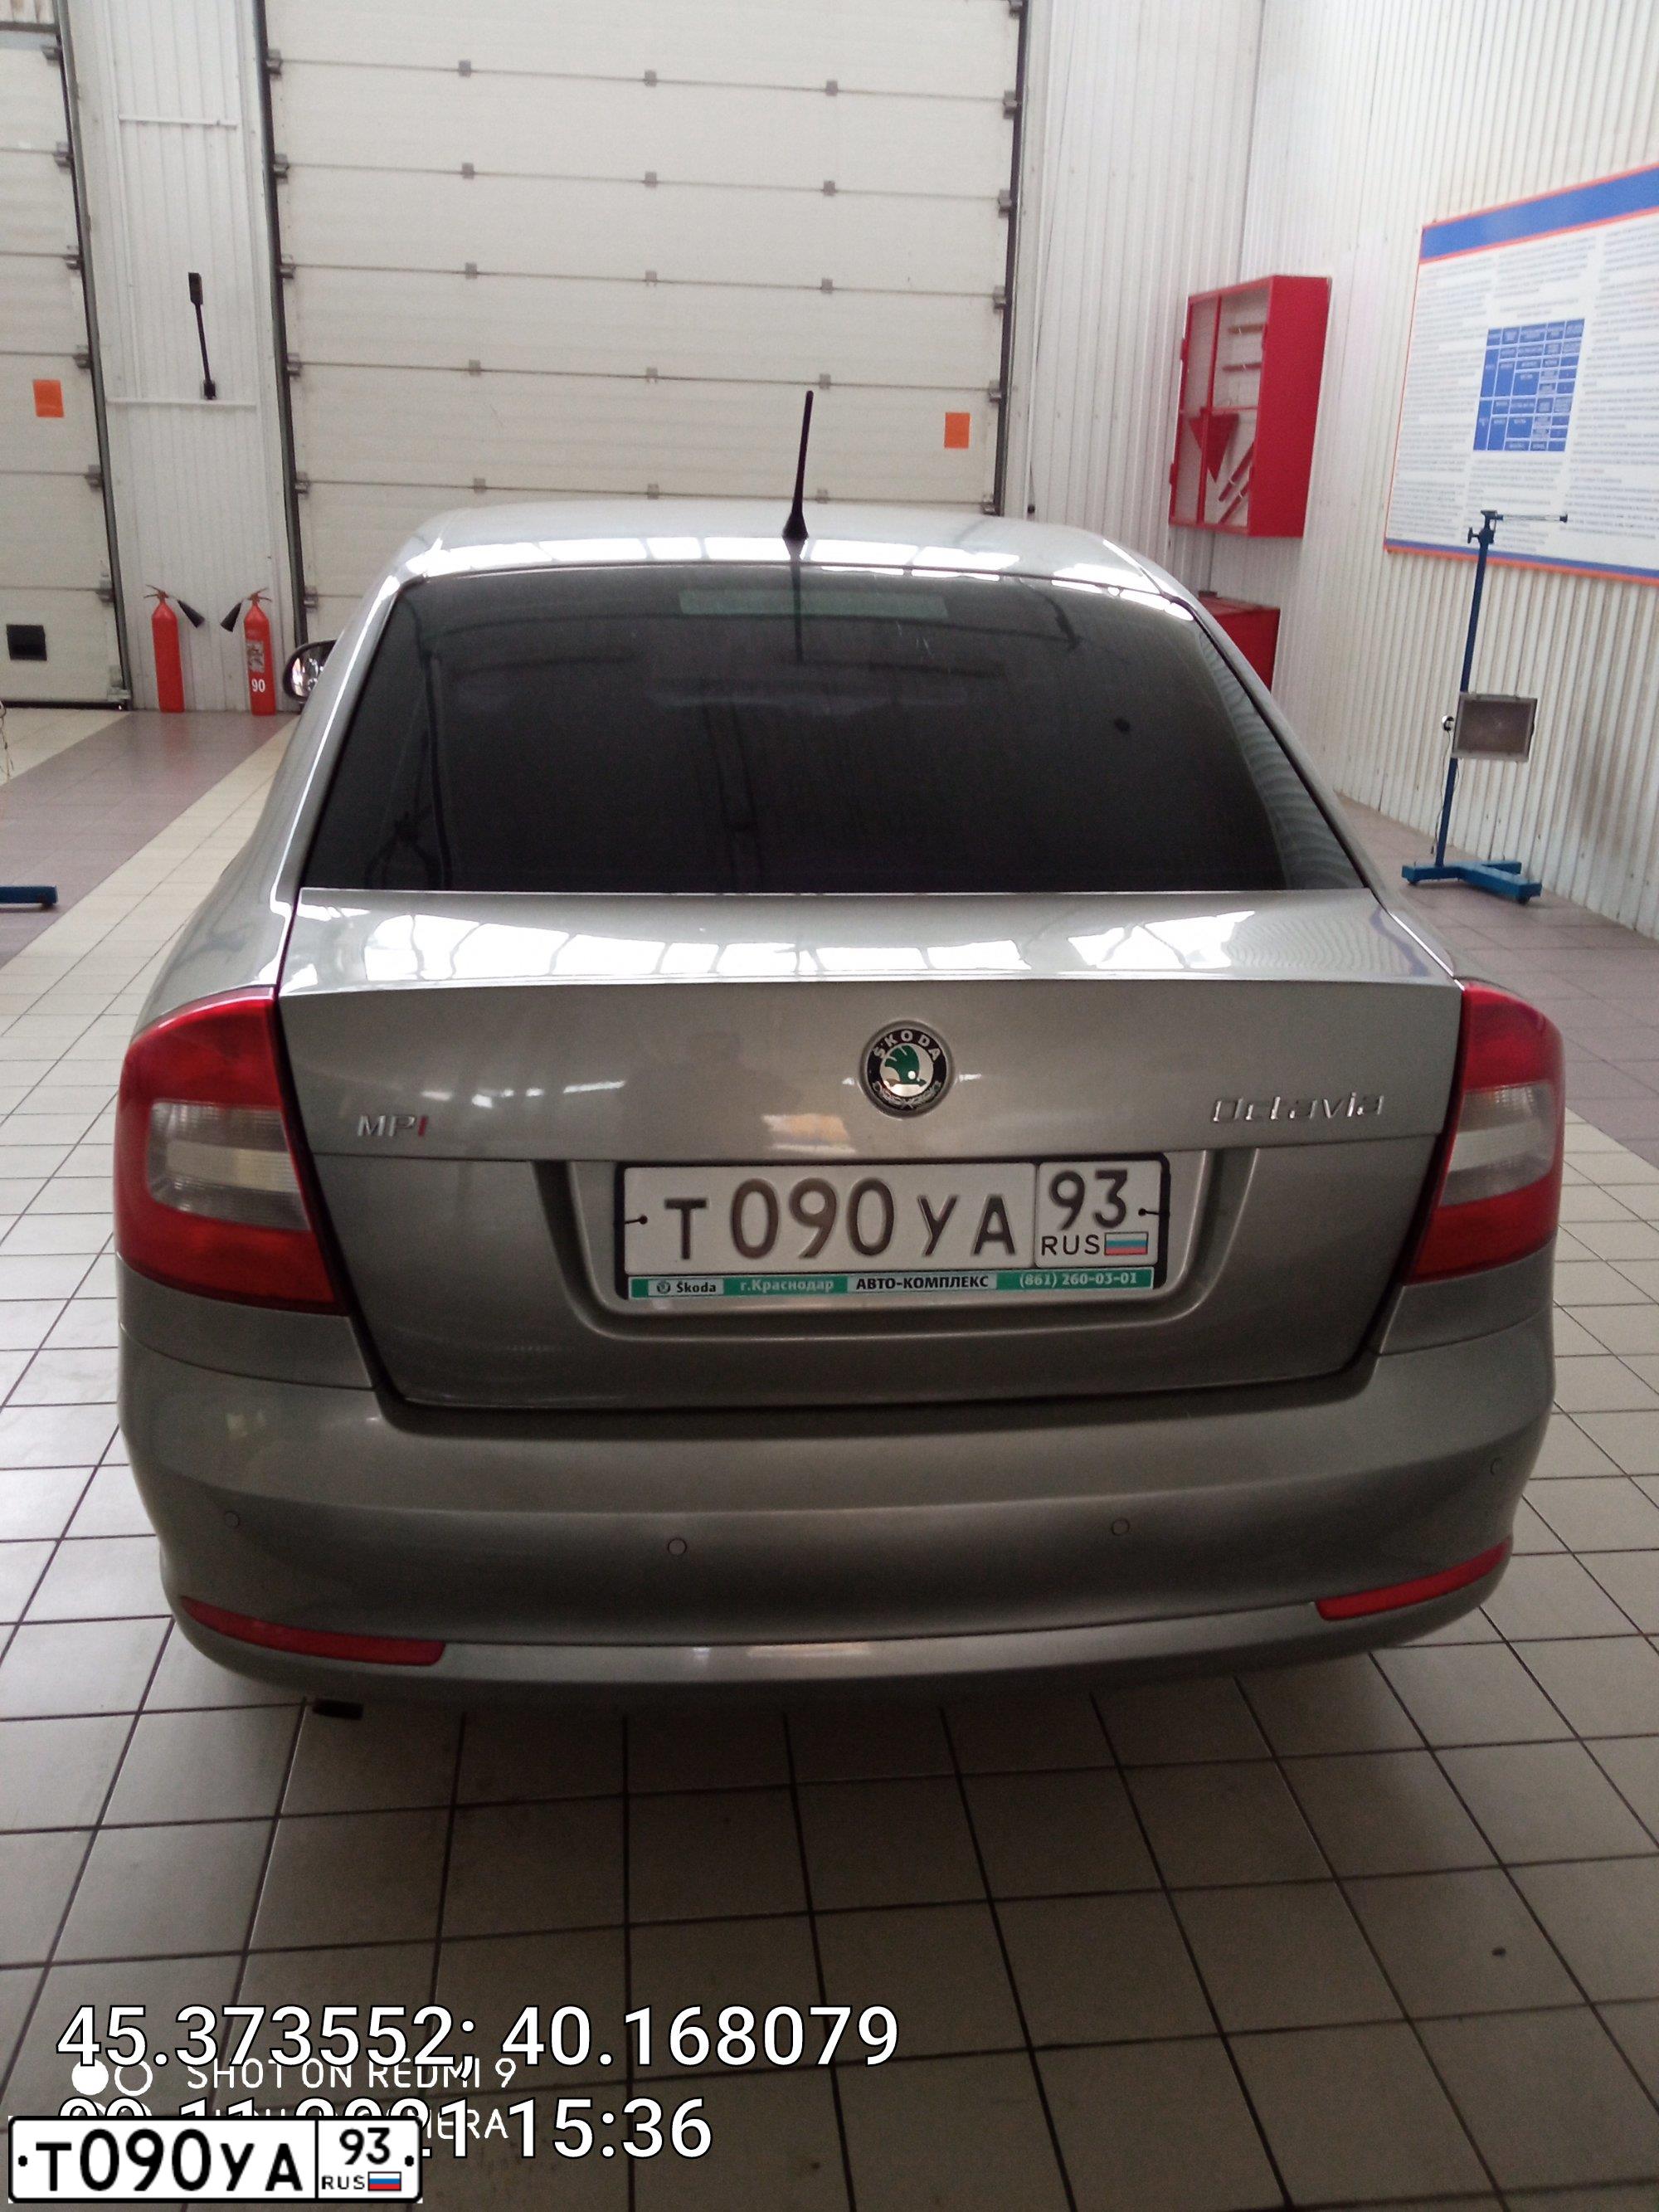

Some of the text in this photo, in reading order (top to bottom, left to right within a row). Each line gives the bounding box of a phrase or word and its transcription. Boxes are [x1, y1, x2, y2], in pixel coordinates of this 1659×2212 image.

[251, 678, 265, 693] 90
[1048, 1170, 1129, 1231] 93
[1041, 1235, 1101, 1255] RUS
[856, 1275, 989, 1290] АВТО-КОМПЛЕКС
[1019, 1272, 1057, 1289] (861)
[1062, 1272, 1137, 1286] 260-03-01
